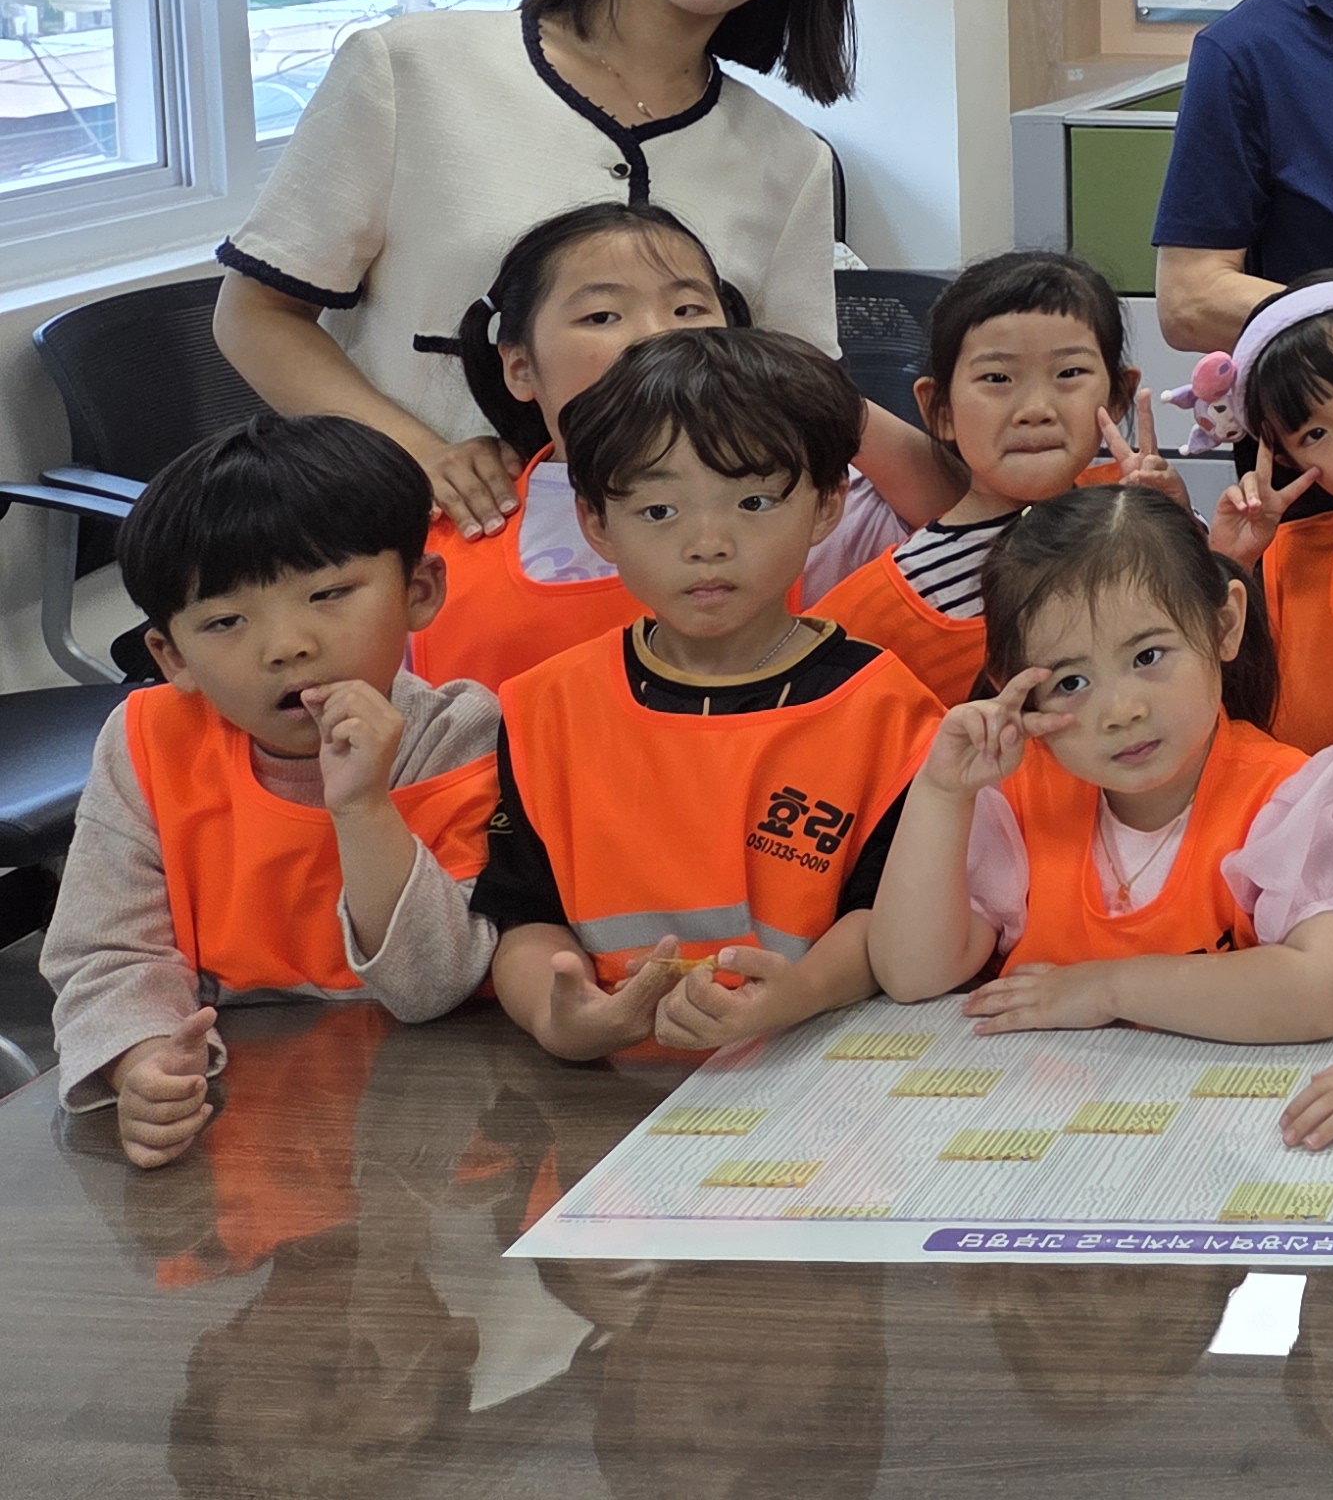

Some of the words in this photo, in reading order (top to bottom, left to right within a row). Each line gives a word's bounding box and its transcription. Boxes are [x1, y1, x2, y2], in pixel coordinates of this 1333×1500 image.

[757, 786, 855, 855] 효림
[746, 833, 830, 874] 051)335-0019
[957, 1232, 1064, 1250] 간부명단
